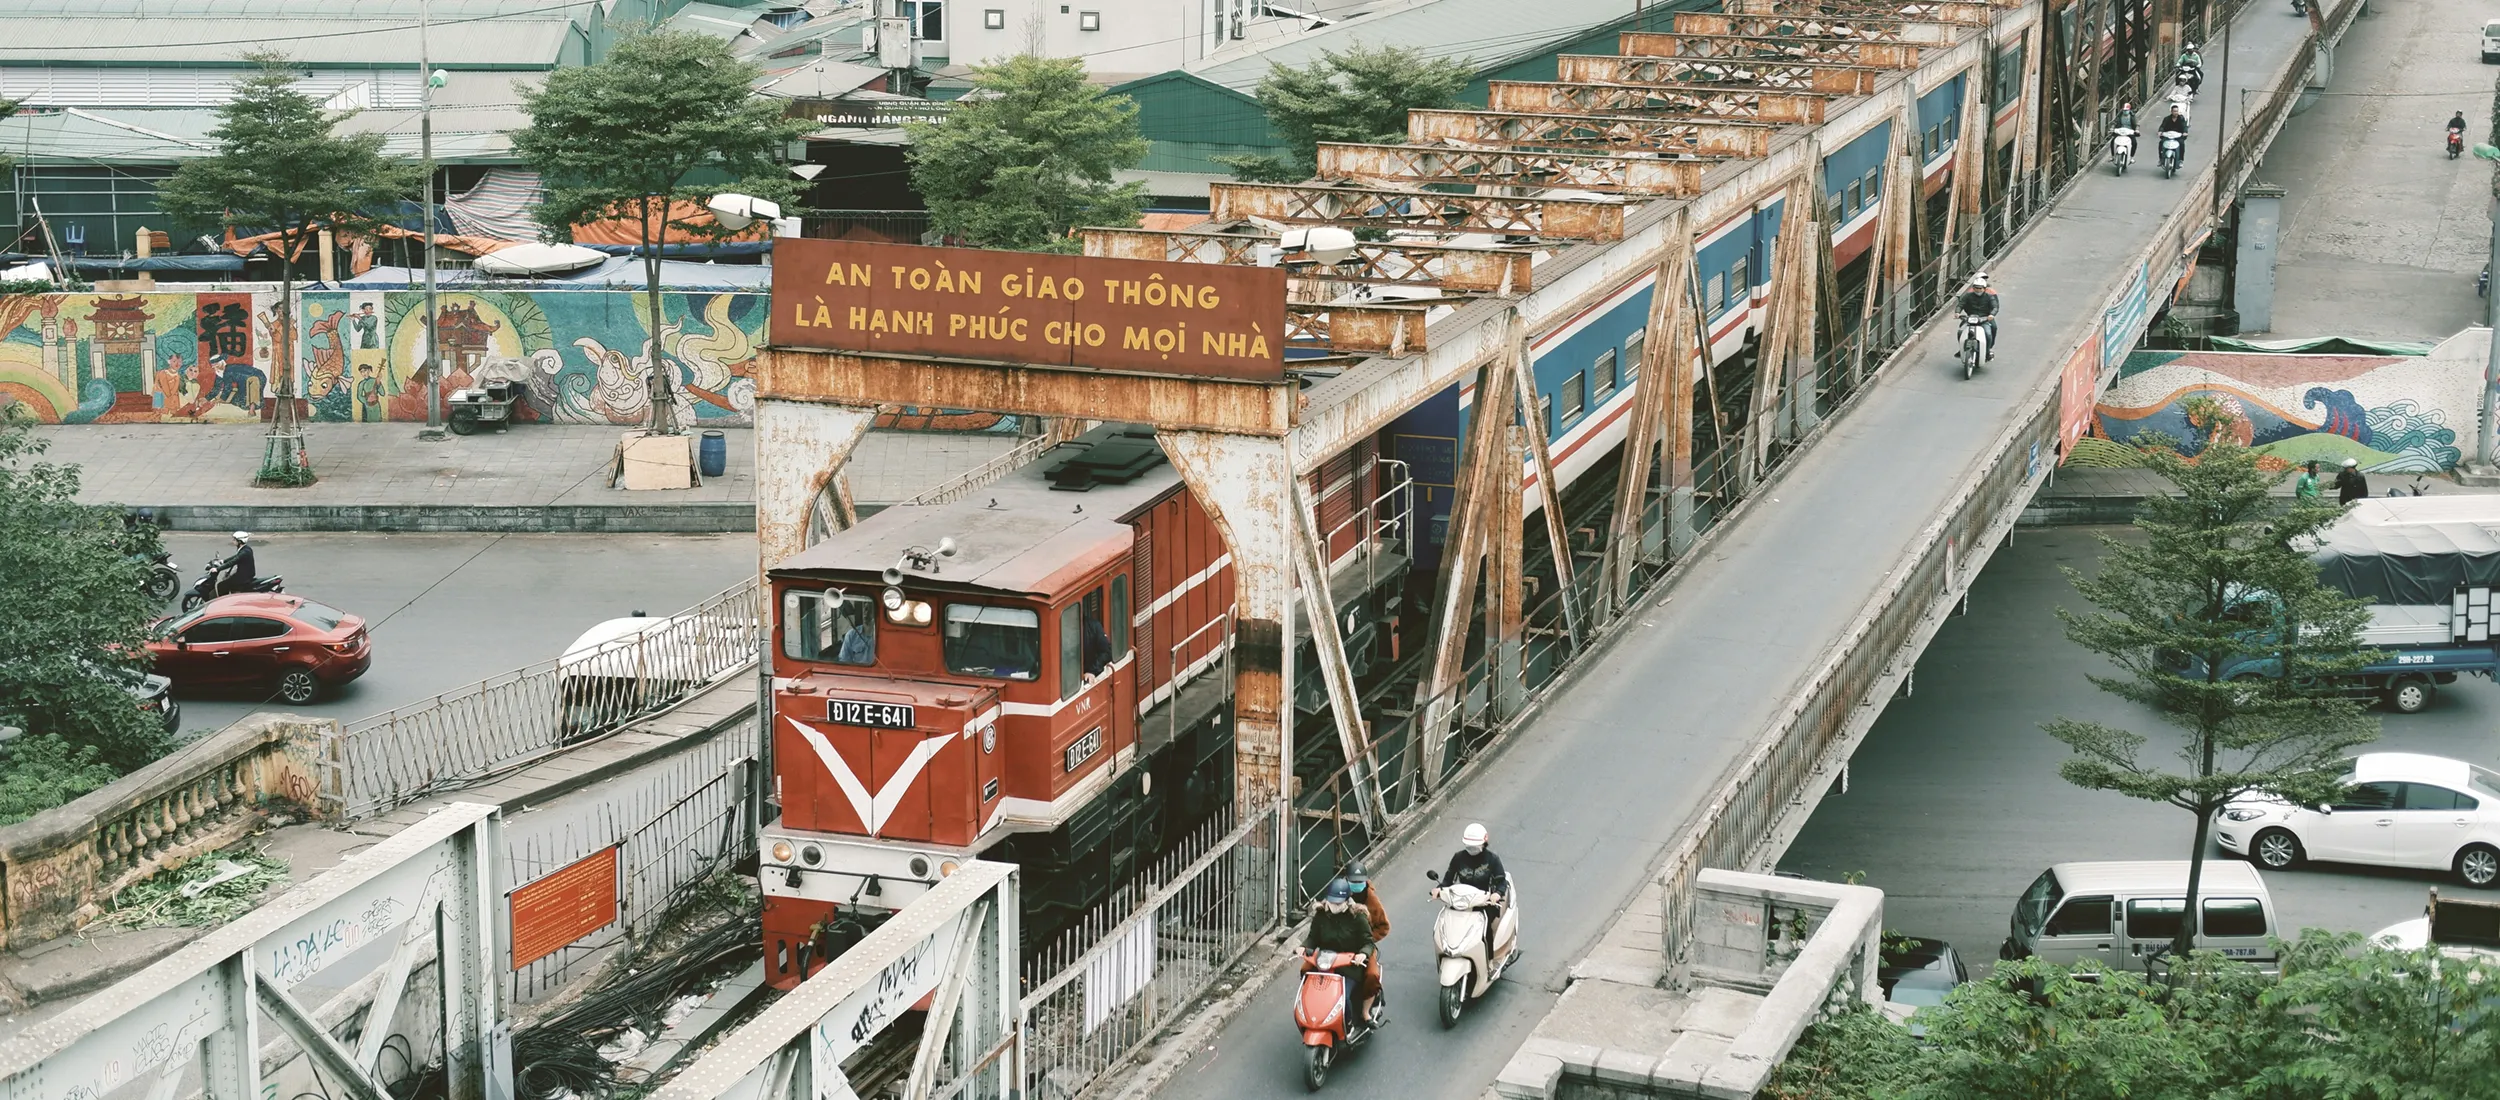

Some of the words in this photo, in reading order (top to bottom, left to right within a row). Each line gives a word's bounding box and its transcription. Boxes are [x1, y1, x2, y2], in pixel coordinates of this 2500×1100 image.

[825, 262, 872, 287] AN
[891, 259, 982, 294] TOÀN
[1104, 273, 1220, 309] THÔNG
[795, 294, 833, 329] LÀ
[849, 306, 934, 339] HẠNH
[949, 305, 1028, 342] PHÚC
[1044, 320, 1106, 347] CHO
[1202, 321, 1270, 360] NHÀ
